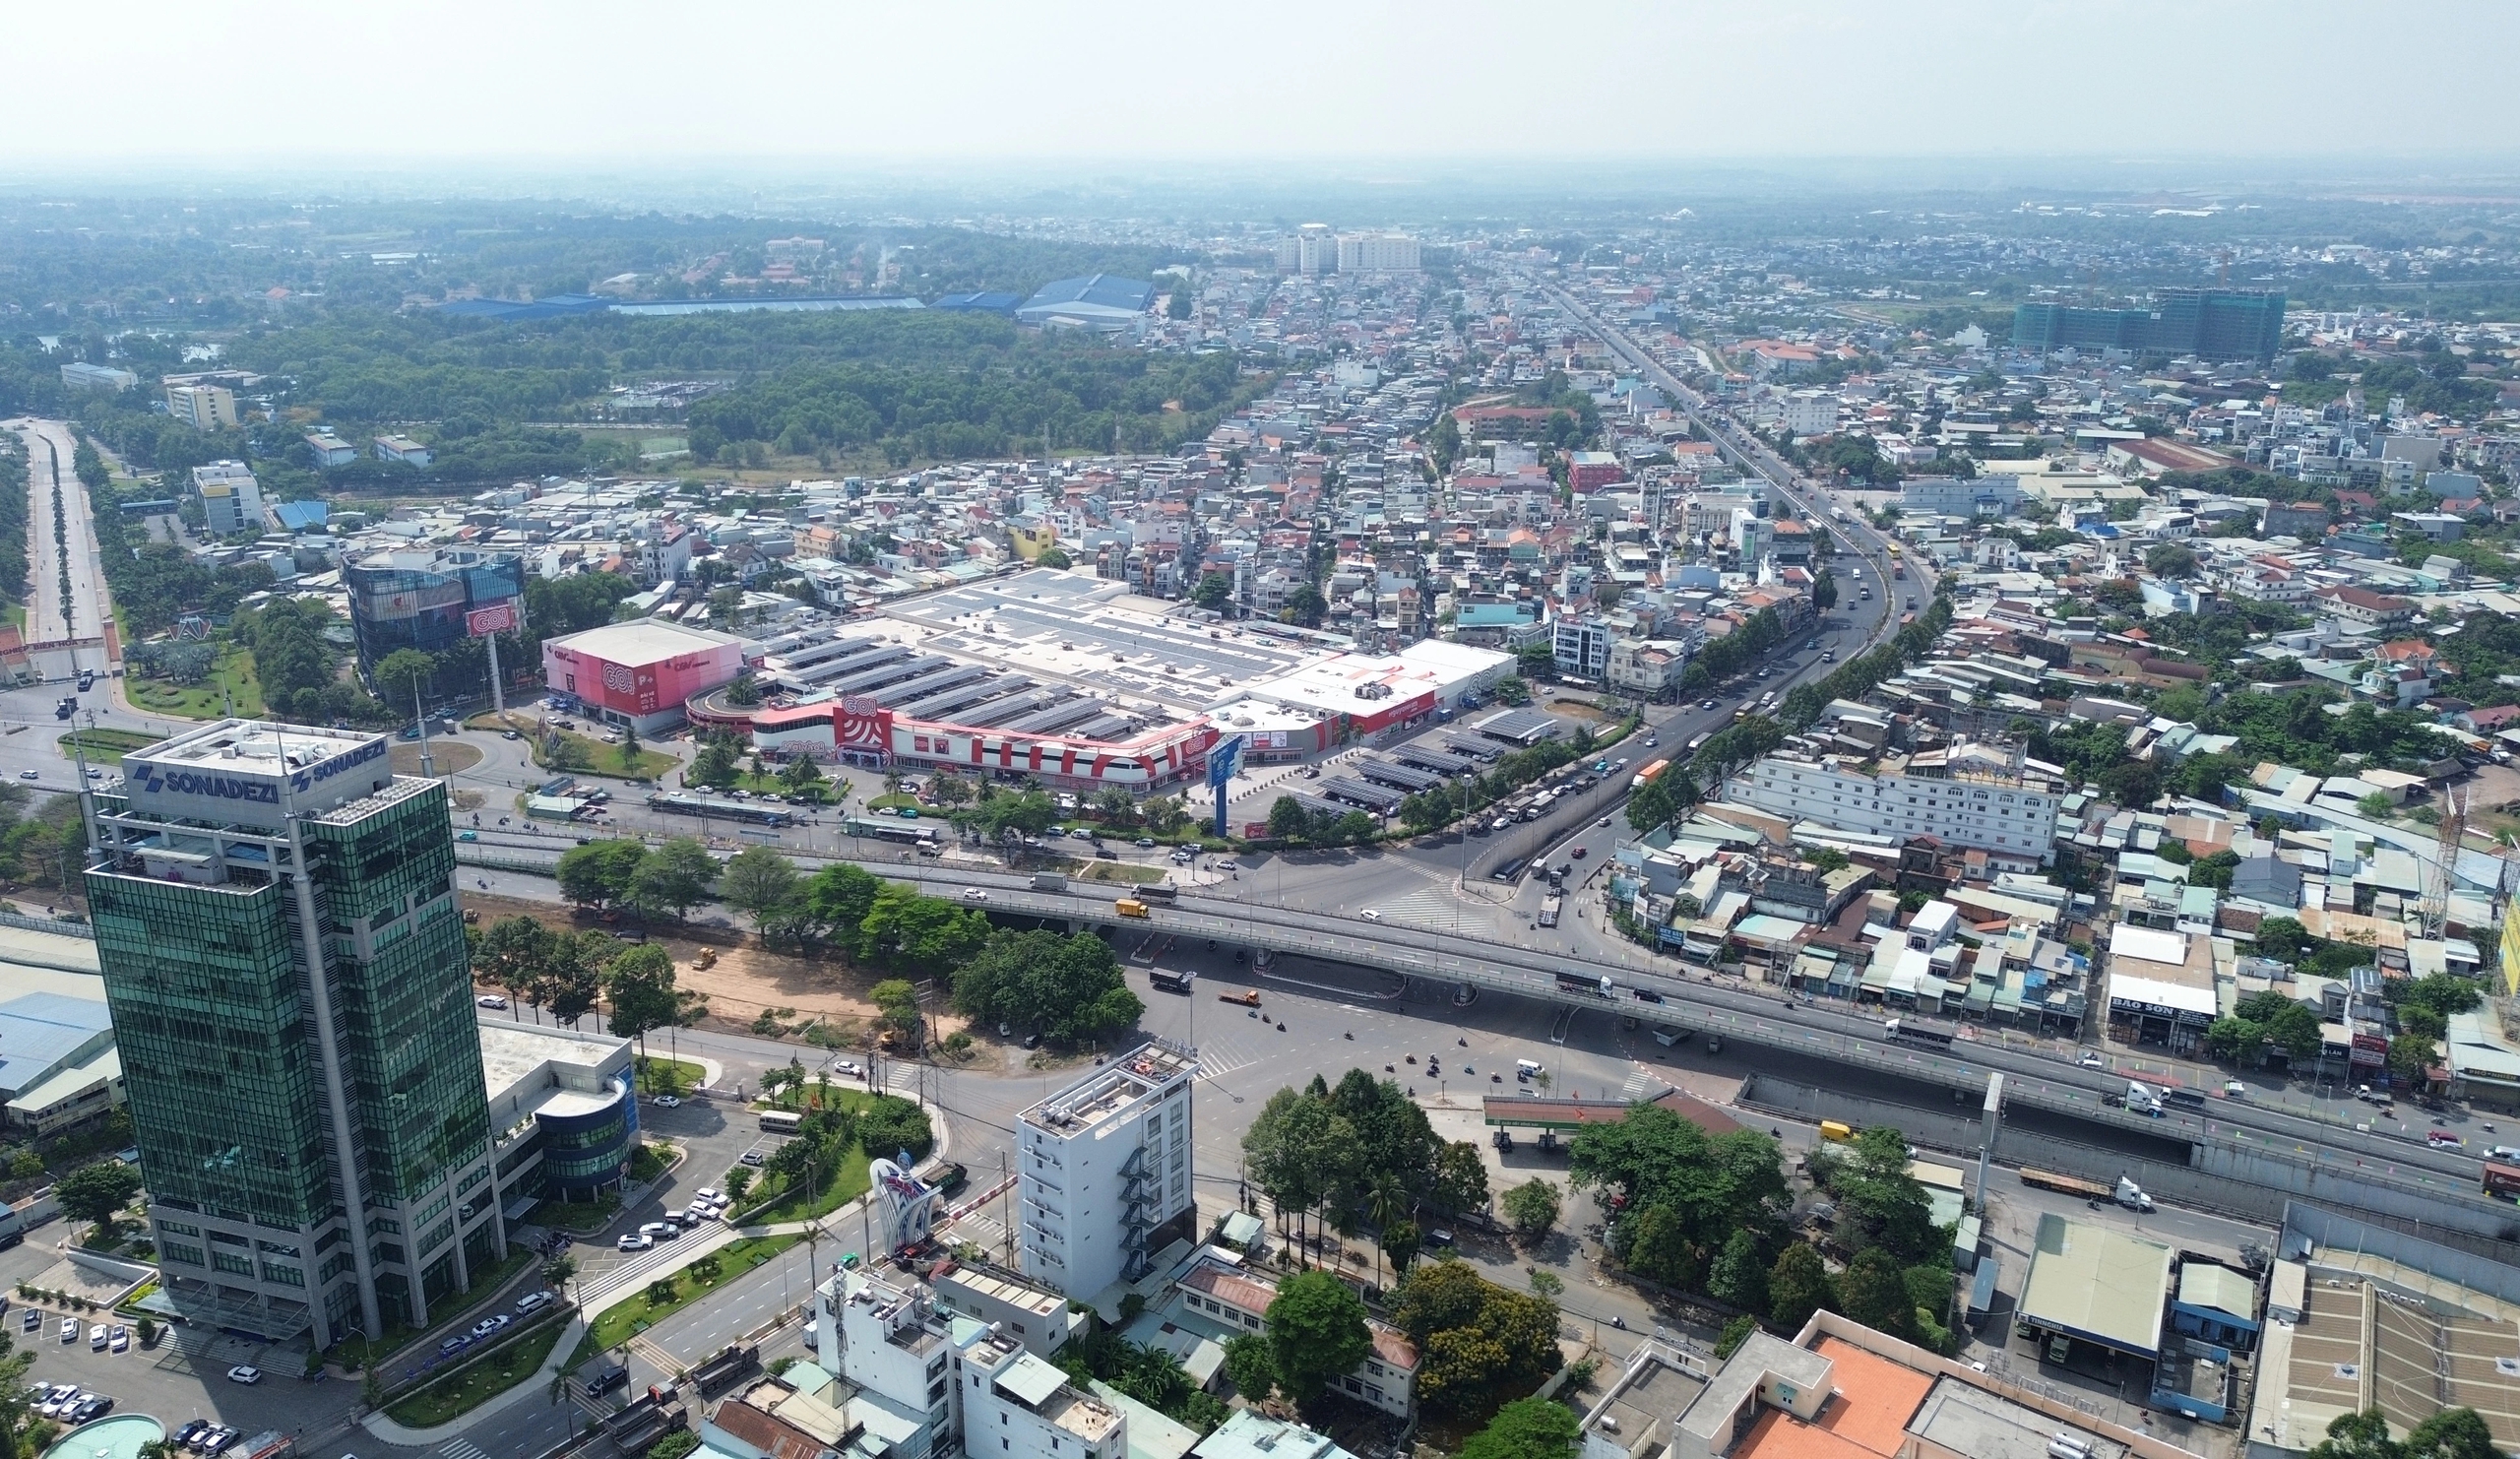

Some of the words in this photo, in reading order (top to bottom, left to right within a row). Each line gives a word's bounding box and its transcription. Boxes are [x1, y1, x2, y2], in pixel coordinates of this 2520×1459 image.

[472, 607, 510, 633] GO!
[602, 663, 635, 695] GO!
[842, 695, 878, 717] GO!
[313, 740, 387, 782] SONADEZI
[165, 771, 280, 804] SONADEZI
